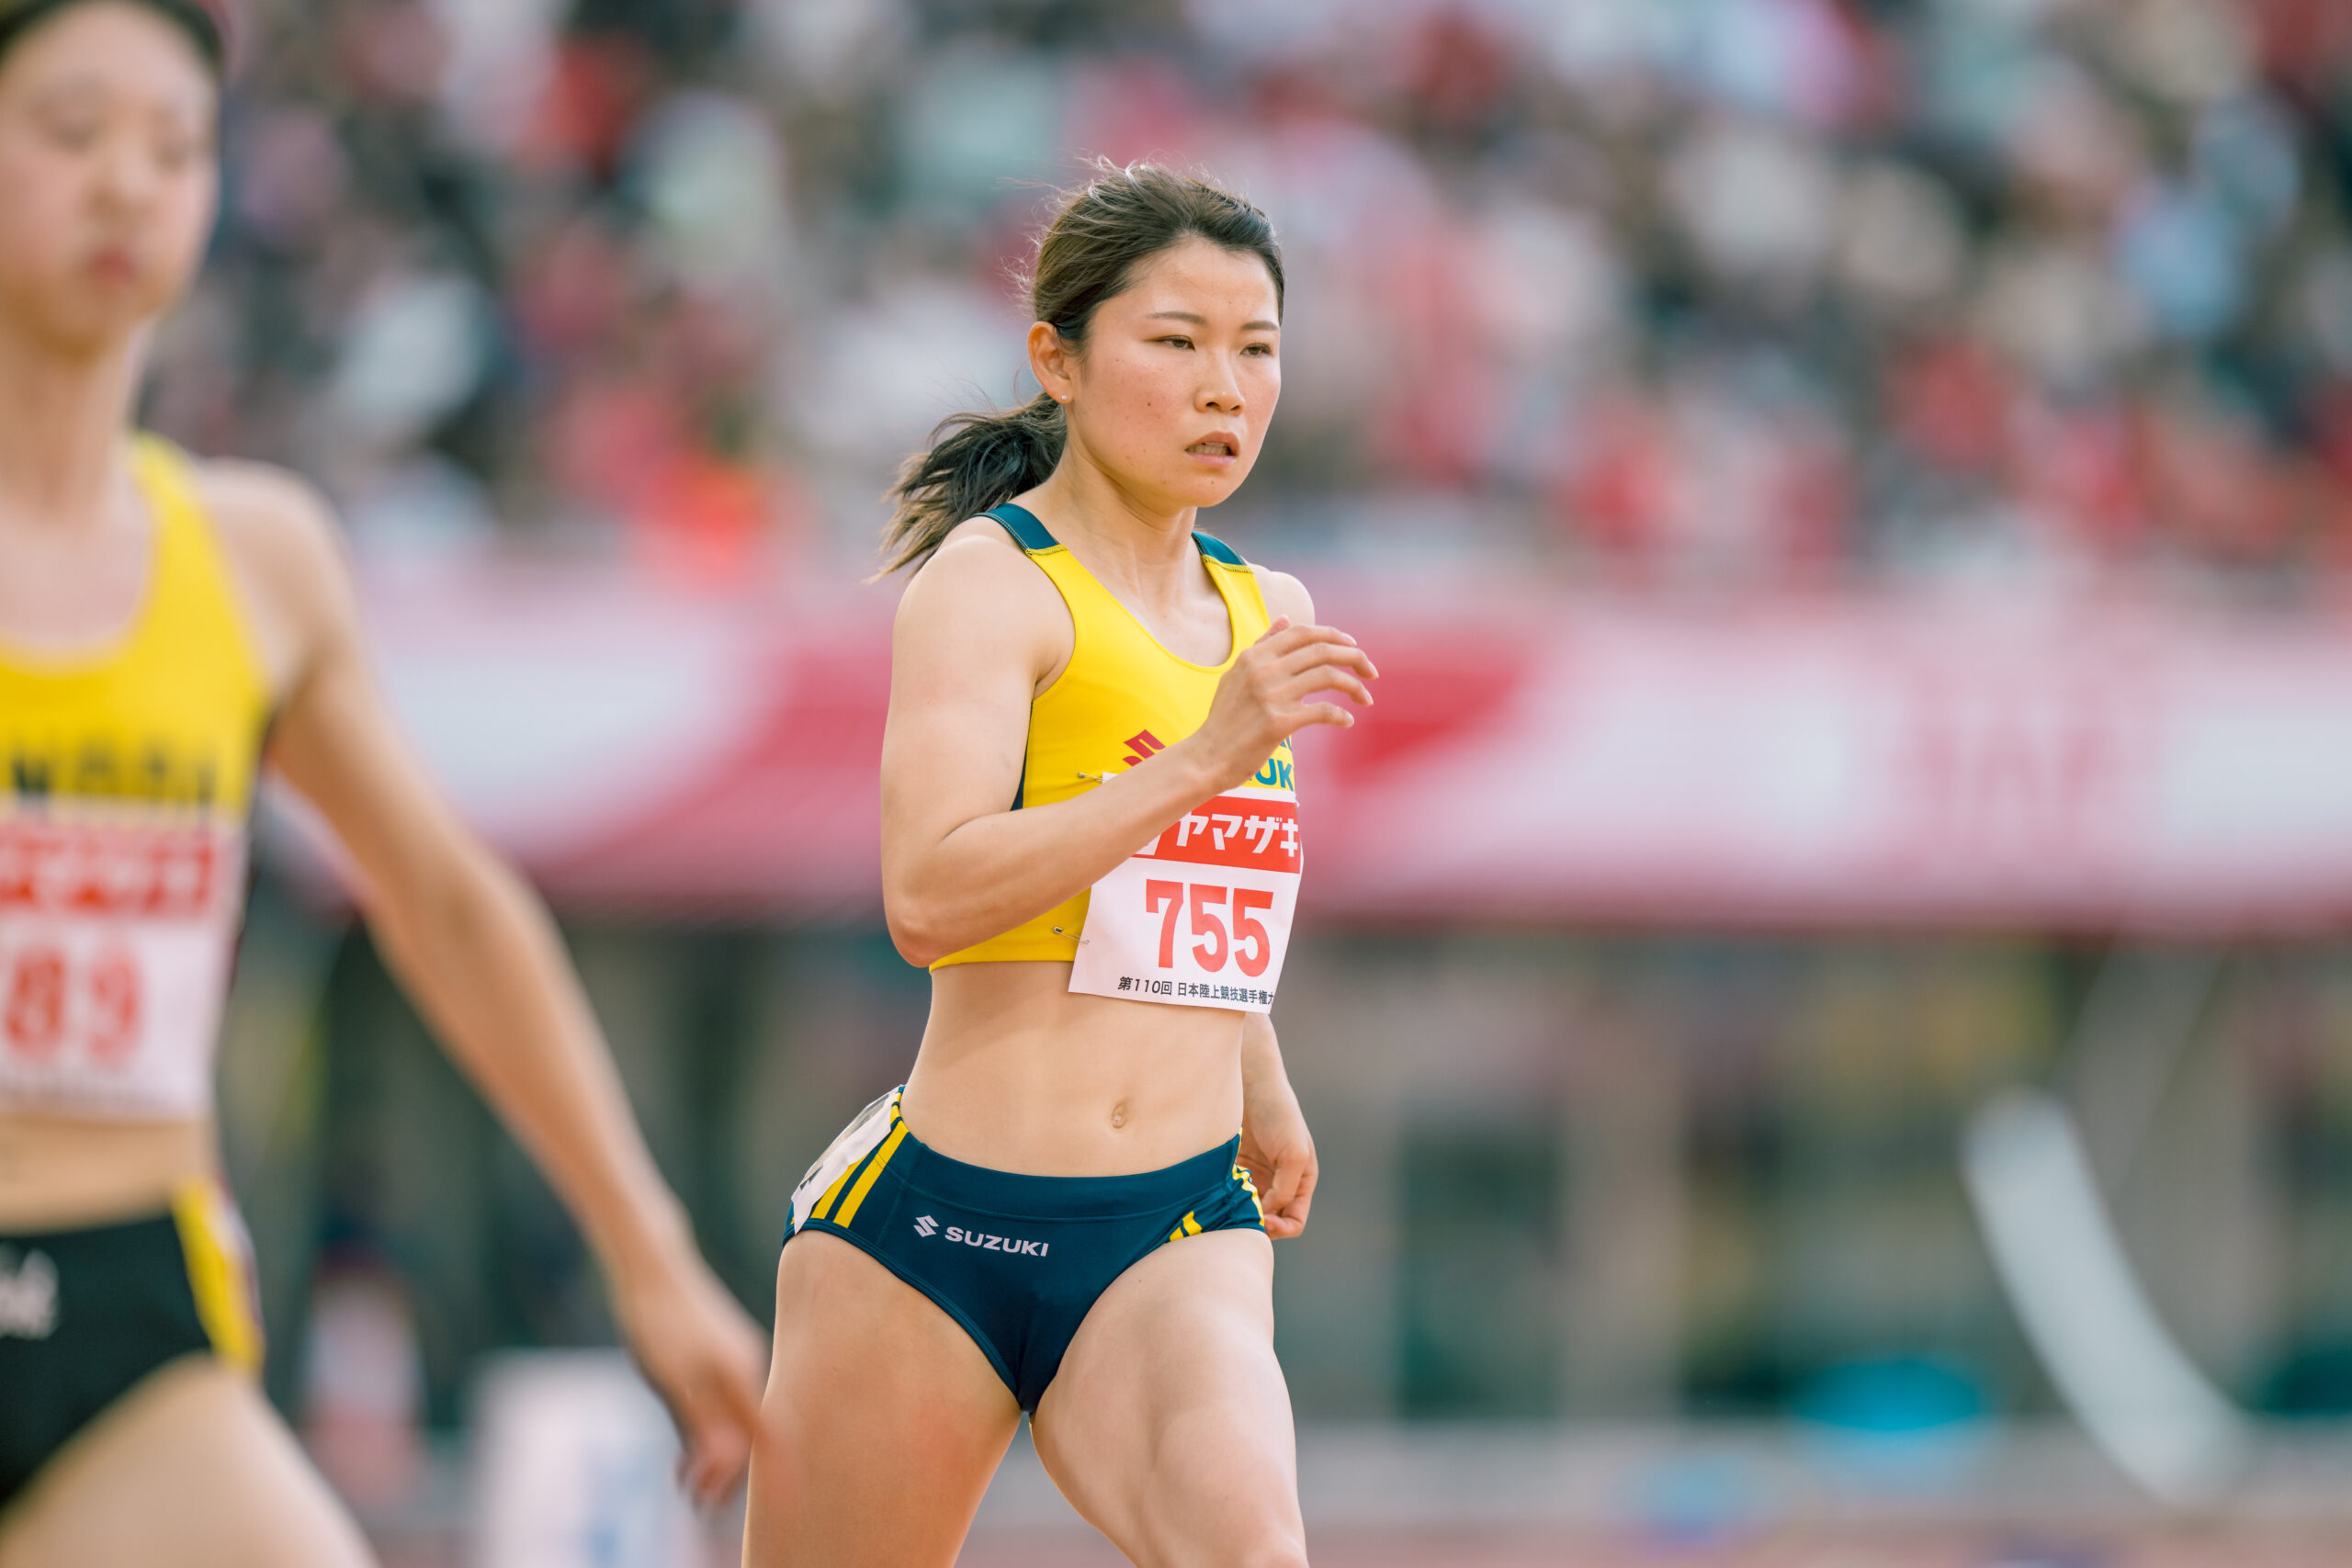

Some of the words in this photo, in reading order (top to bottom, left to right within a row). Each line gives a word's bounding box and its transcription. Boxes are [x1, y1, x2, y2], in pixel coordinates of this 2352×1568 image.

[1176, 810, 1299, 858] ヤマザキ
[1146, 878, 1274, 978] 755
[1117, 976, 1173, 996] 第110回
[944, 1226, 1049, 1257] SUZUKI
